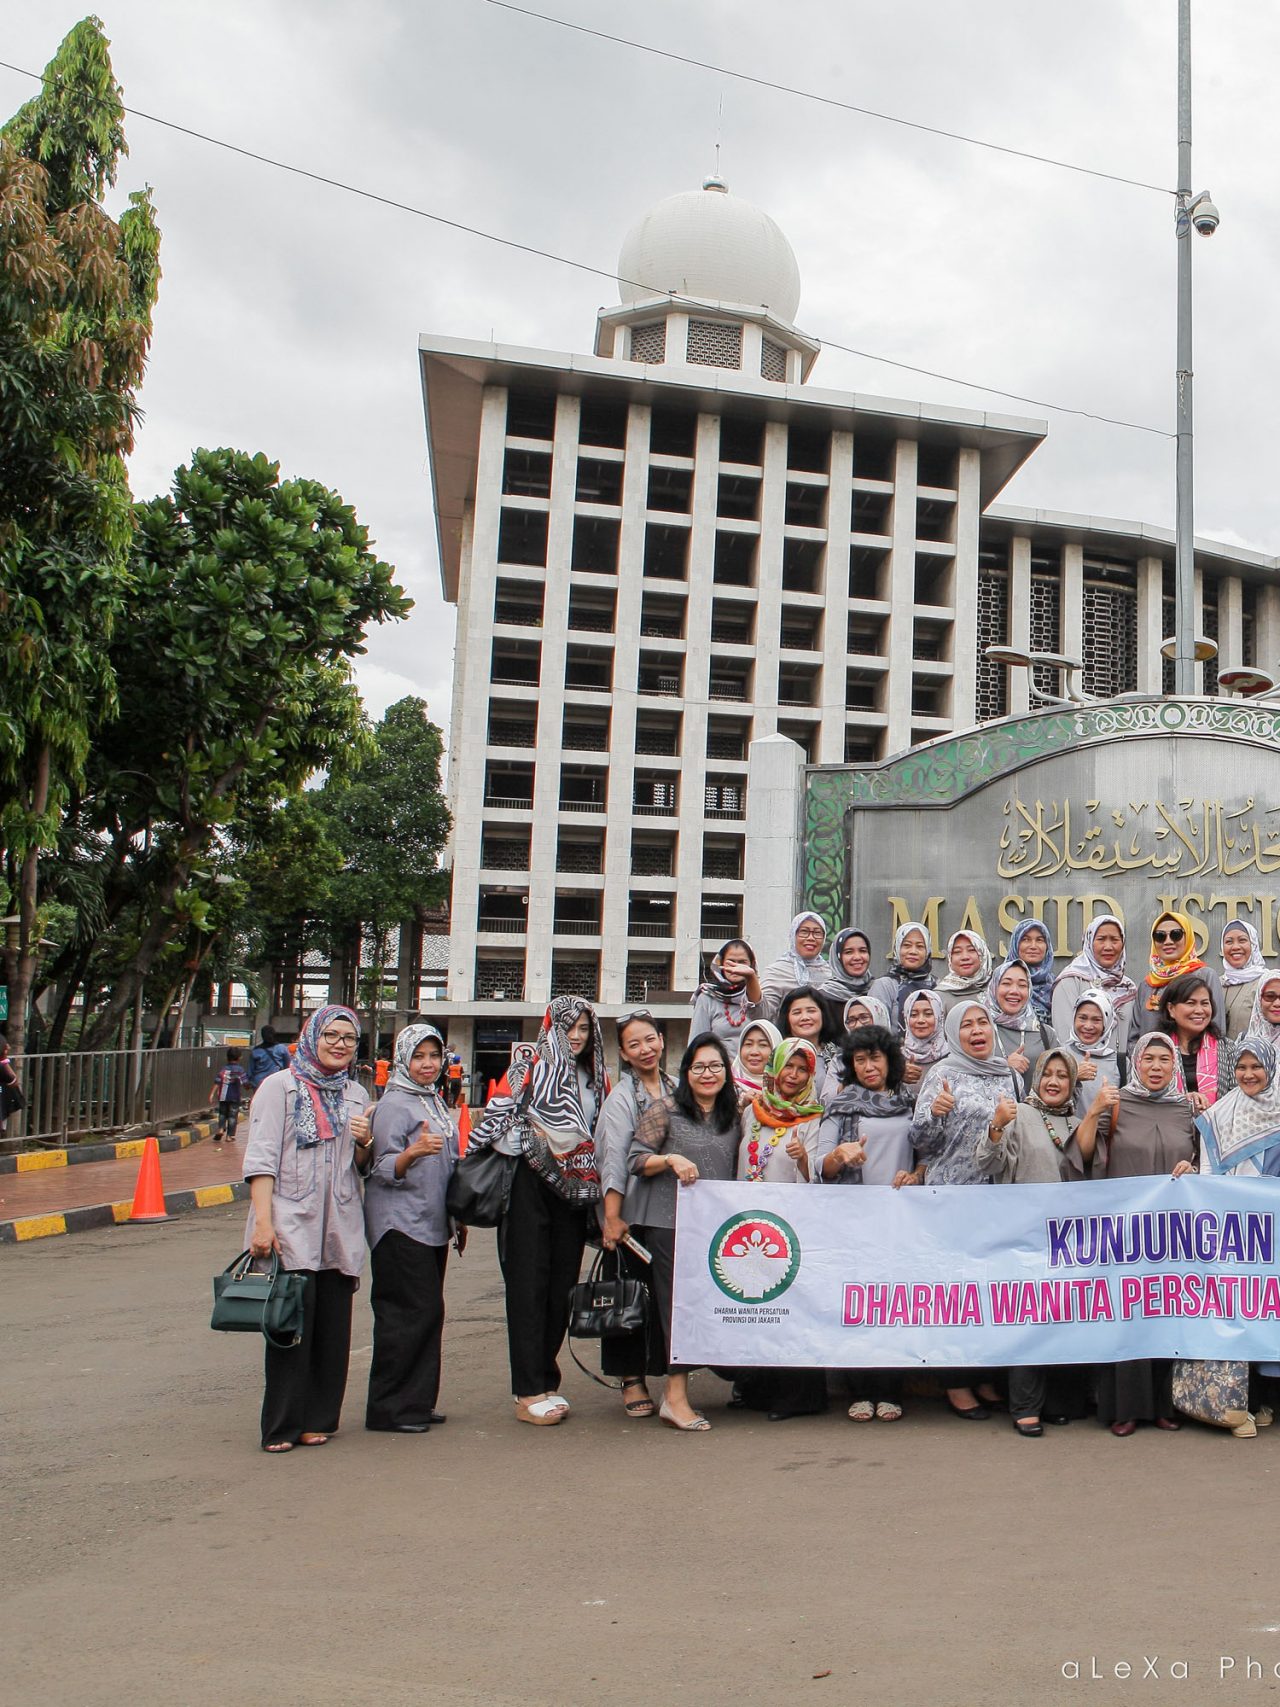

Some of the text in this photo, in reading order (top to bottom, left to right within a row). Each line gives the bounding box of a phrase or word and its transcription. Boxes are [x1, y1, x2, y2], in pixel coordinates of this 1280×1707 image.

[1047, 1210, 1274, 1268] KUNJUNGAN
[714, 1307, 790, 1316] DHARMA WANITA PERSATUAN
[841, 1281, 983, 1328] DHARMA
[988, 1278, 1116, 1326] WANITA
[722, 1316, 747, 1324] PROVINSI
[757, 1316, 781, 1324] JAKARTA
